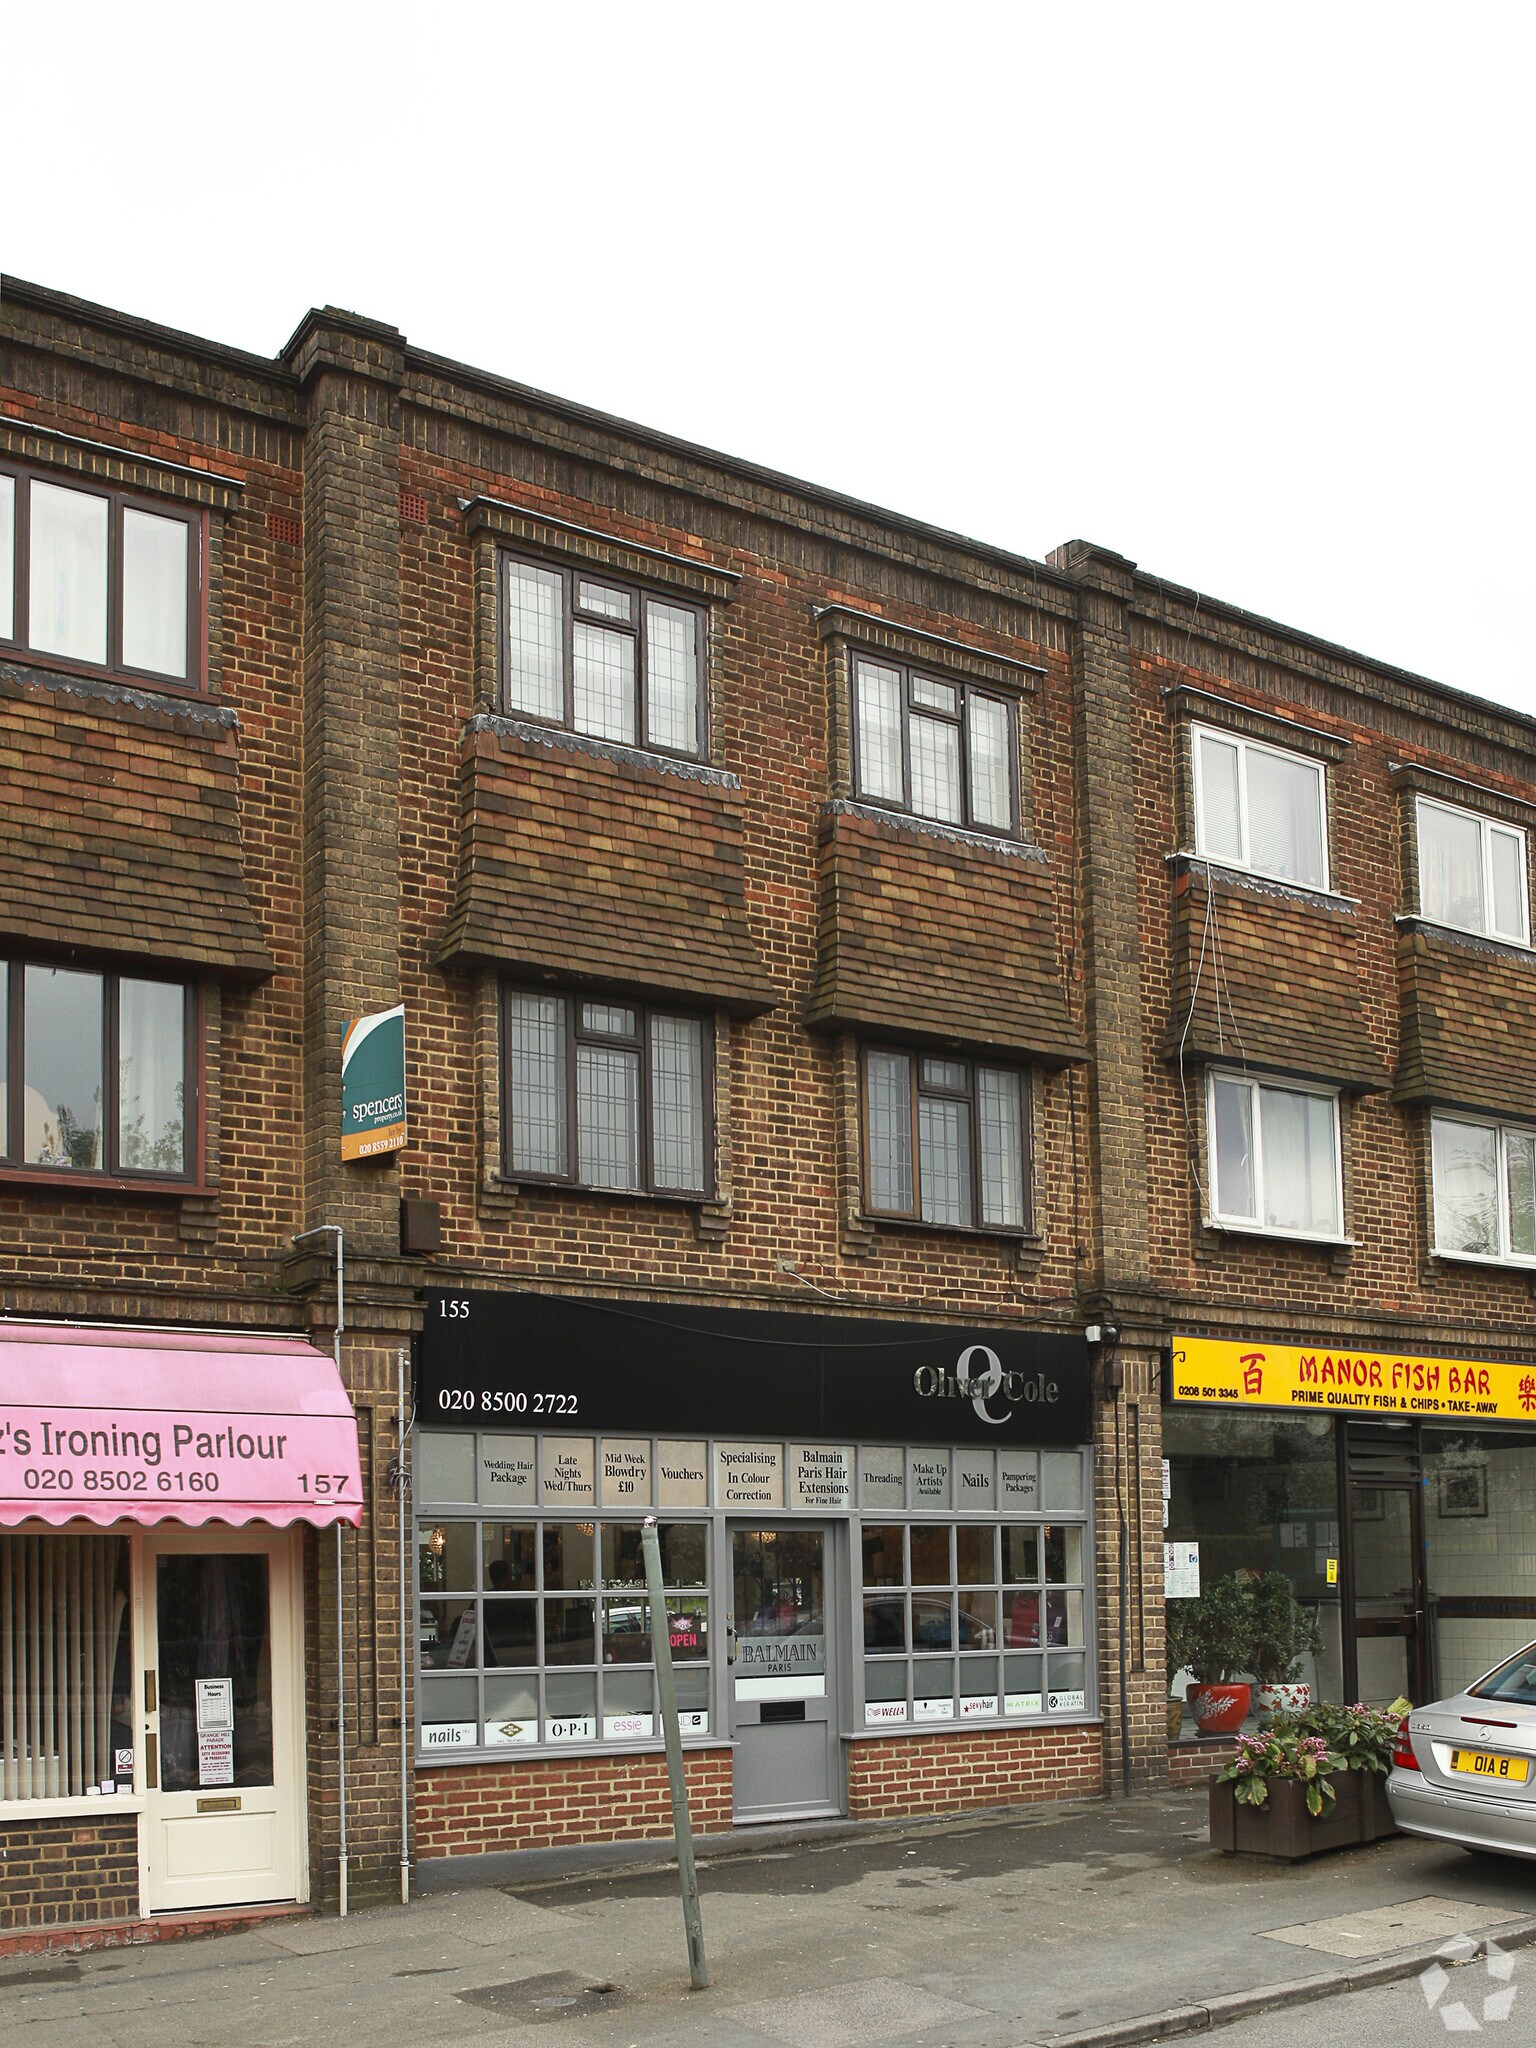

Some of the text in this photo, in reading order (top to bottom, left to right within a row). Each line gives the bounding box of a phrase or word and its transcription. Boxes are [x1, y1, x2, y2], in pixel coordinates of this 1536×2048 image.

[353, 1093, 403, 1123] spencers
[359, 1143, 372, 1155] 020
[372, 1139, 389, 1152] 8559
[440, 1299, 470, 1319] 155
[1239, 1353, 1266, 1396] 百
[1300, 1355, 1491, 1396] MANOR FISH BAR
[913, 1365, 1059, 1403] Oliver Cole
[1178, 1385, 1239, 1399] 0208 501 3345
[438, 1389, 579, 1415] 020 8500 2722
[1291, 1390, 1499, 1414] PRIME QUALITY FISH & CHIPS TAKE-AWAY
[40, 1421, 162, 1466] Ironing
[173, 1424, 288, 1459] Parlour
[558, 1454, 578, 1466] Late
[605, 1453, 646, 1464] Mid Week
[720, 1450, 776, 1467] Specialising
[803, 1450, 843, 1463] Balmain
[484, 1460, 534, 1472] Wedding Hair
[604, 1465, 647, 1480] Blowdry
[798, 1466, 848, 1479] Paris Hair
[912, 1463, 947, 1477] Make Up
[23, 1468, 220, 1492] 020 8502 6160
[490, 1471, 528, 1486] Package
[554, 1467, 582, 1480] Nights
[661, 1467, 704, 1481] Vouchers
[728, 1472, 770, 1484] In Colour
[863, 1472, 903, 1486] Threading
[1002, 1471, 1037, 1483] Pampering
[297, 1473, 350, 1494] 157
[544, 1480, 593, 1492] Wed/Thurs
[618, 1481, 635, 1493] £10
[799, 1481, 850, 1495] Extensions
[916, 1476, 943, 1487] Artists
[962, 1473, 990, 1489] Nails
[726, 1488, 772, 1500] Correction
[917, 1488, 942, 1496] Available
[1005, 1482, 1034, 1495] Packages
[805, 1496, 842, 1505] For Fine Hair
[669, 1633, 698, 1648] OPEN
[742, 1643, 817, 1664] BALMAIN
[767, 1663, 792, 1673] PARIS
[1005, 1700, 1039, 1709] MATRIX
[1059, 1700, 1084, 1708] KERATIN
[881, 1706, 904, 1717] WELLA
[613, 1716, 642, 1732] essie
[429, 1728, 461, 1744] nails
[1499, 1759, 1510, 1776] 8
